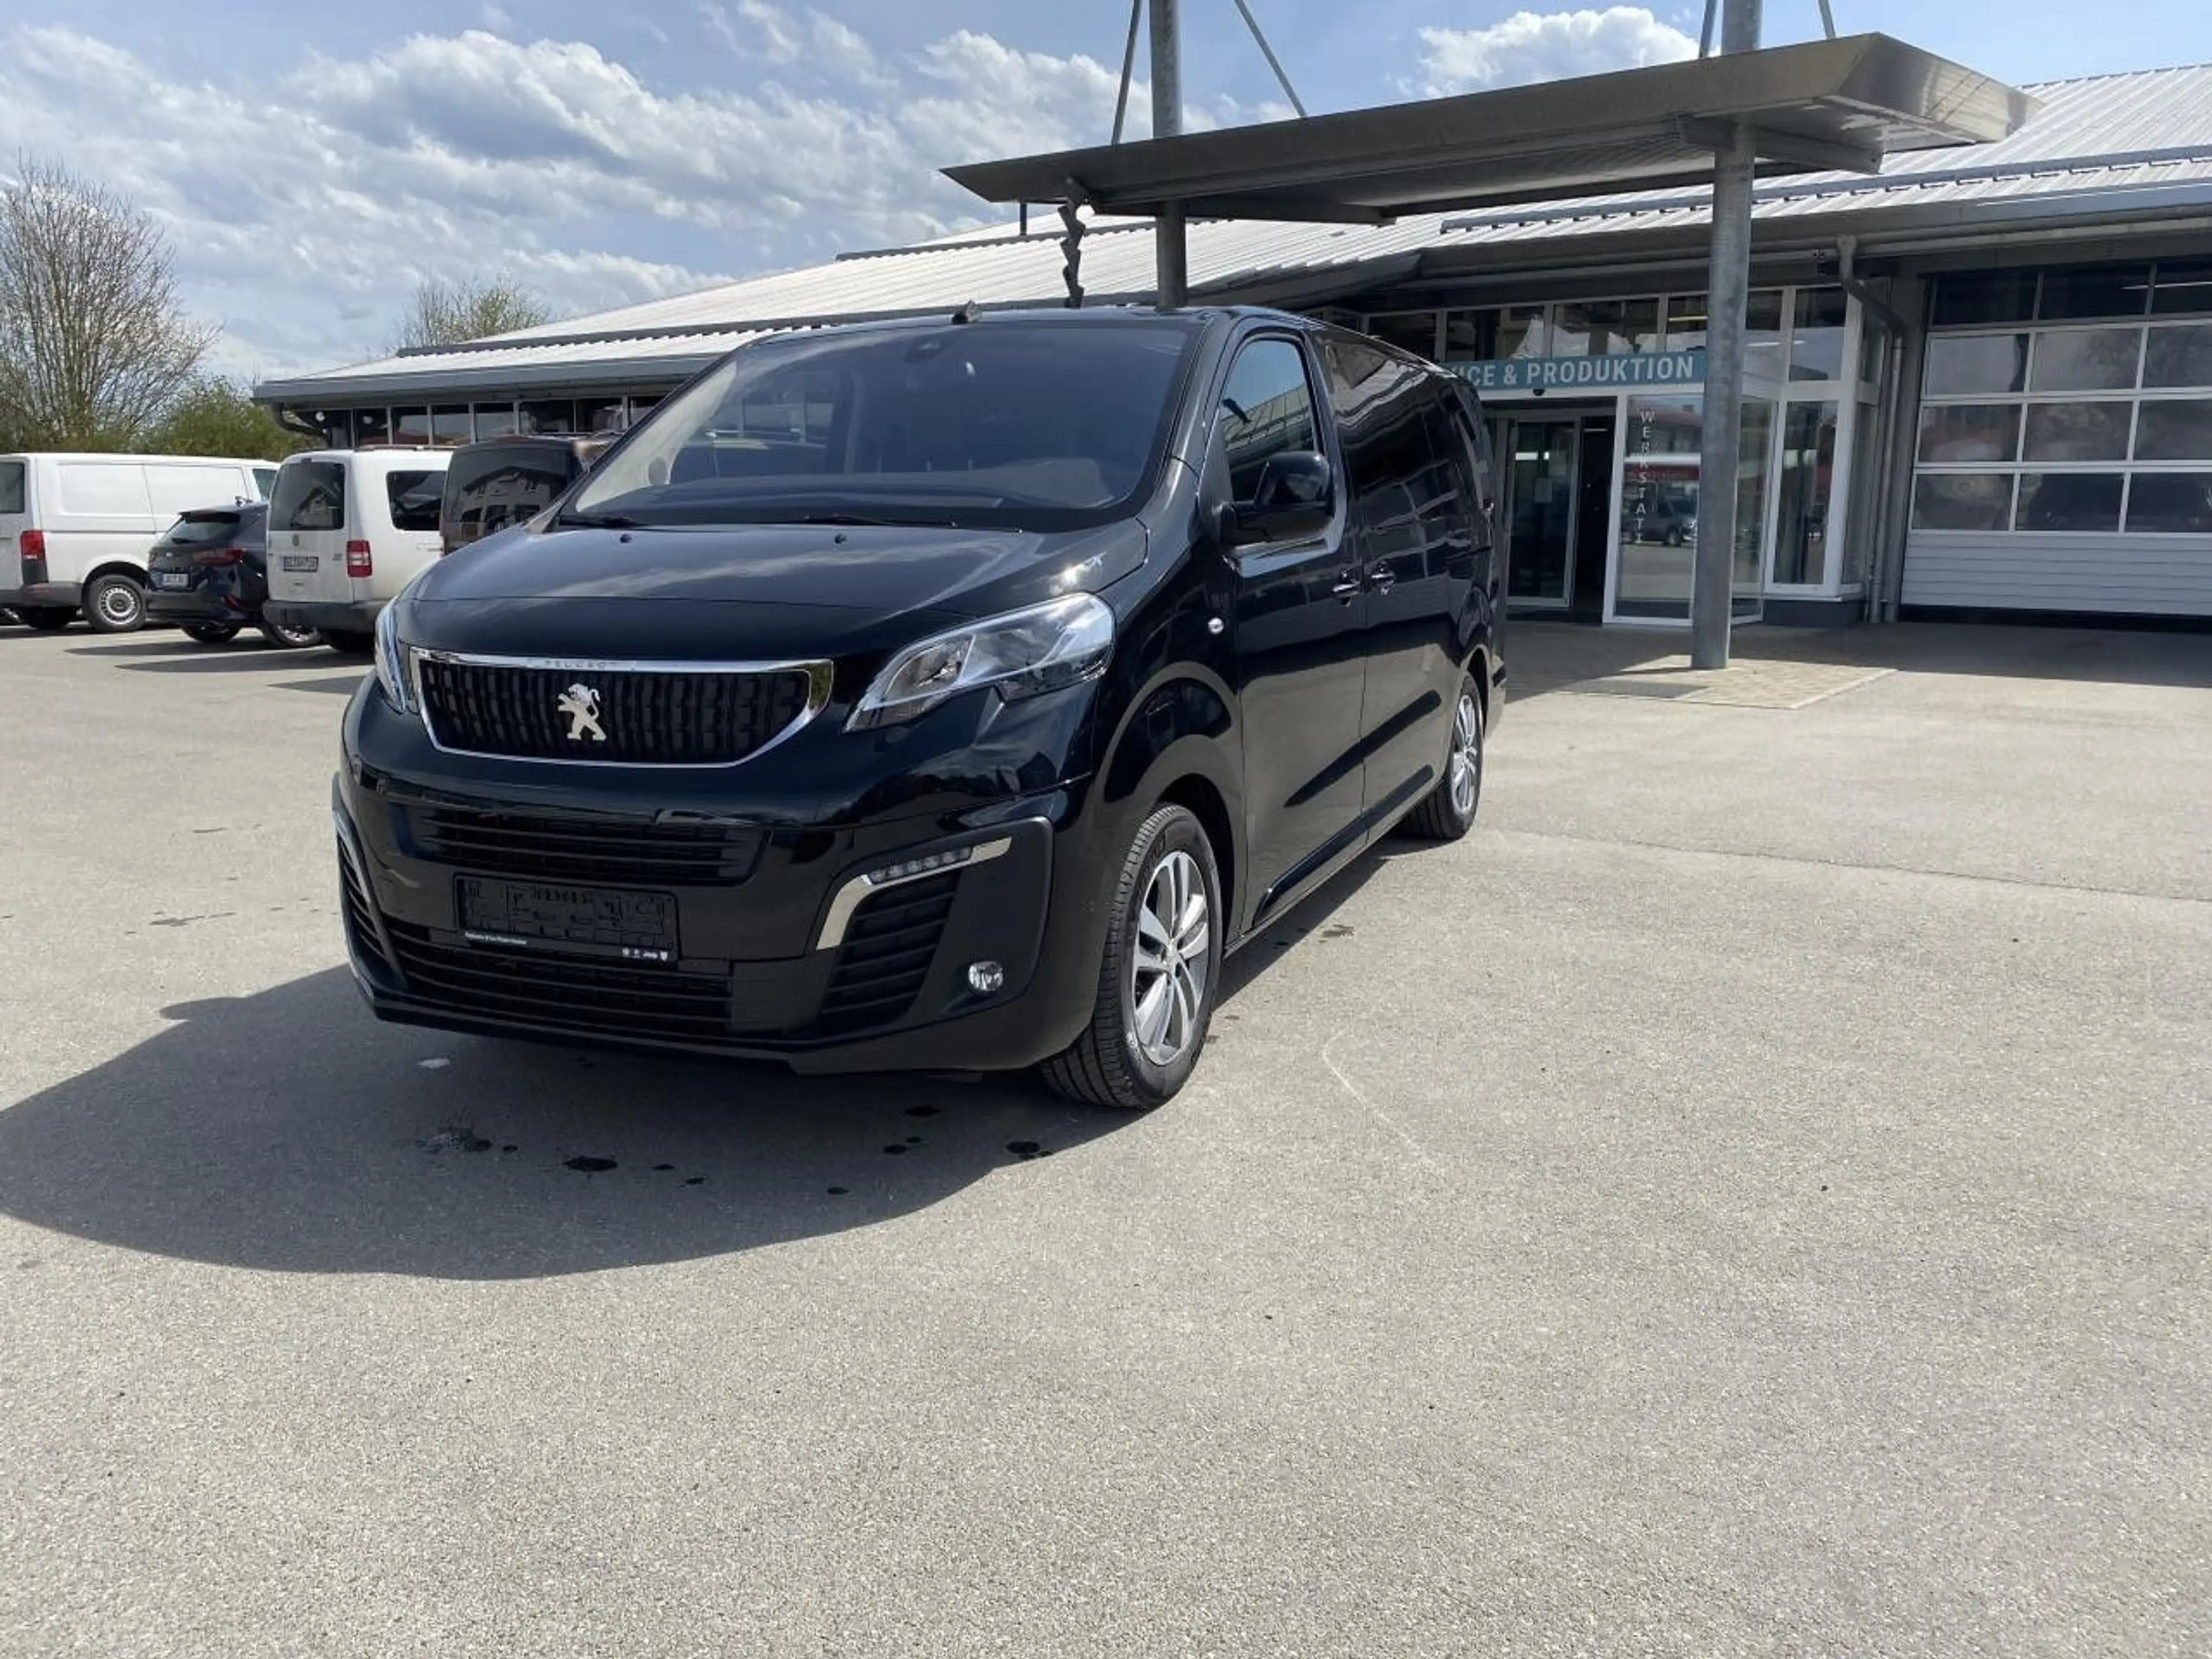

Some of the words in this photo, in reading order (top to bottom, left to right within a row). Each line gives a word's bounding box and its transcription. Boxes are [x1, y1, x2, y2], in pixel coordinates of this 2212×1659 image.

[1503, 364, 1516, 385] &
[1526, 356, 1694, 385] PRODUKTION
[1635, 411, 1655, 544] WERKSTATT
